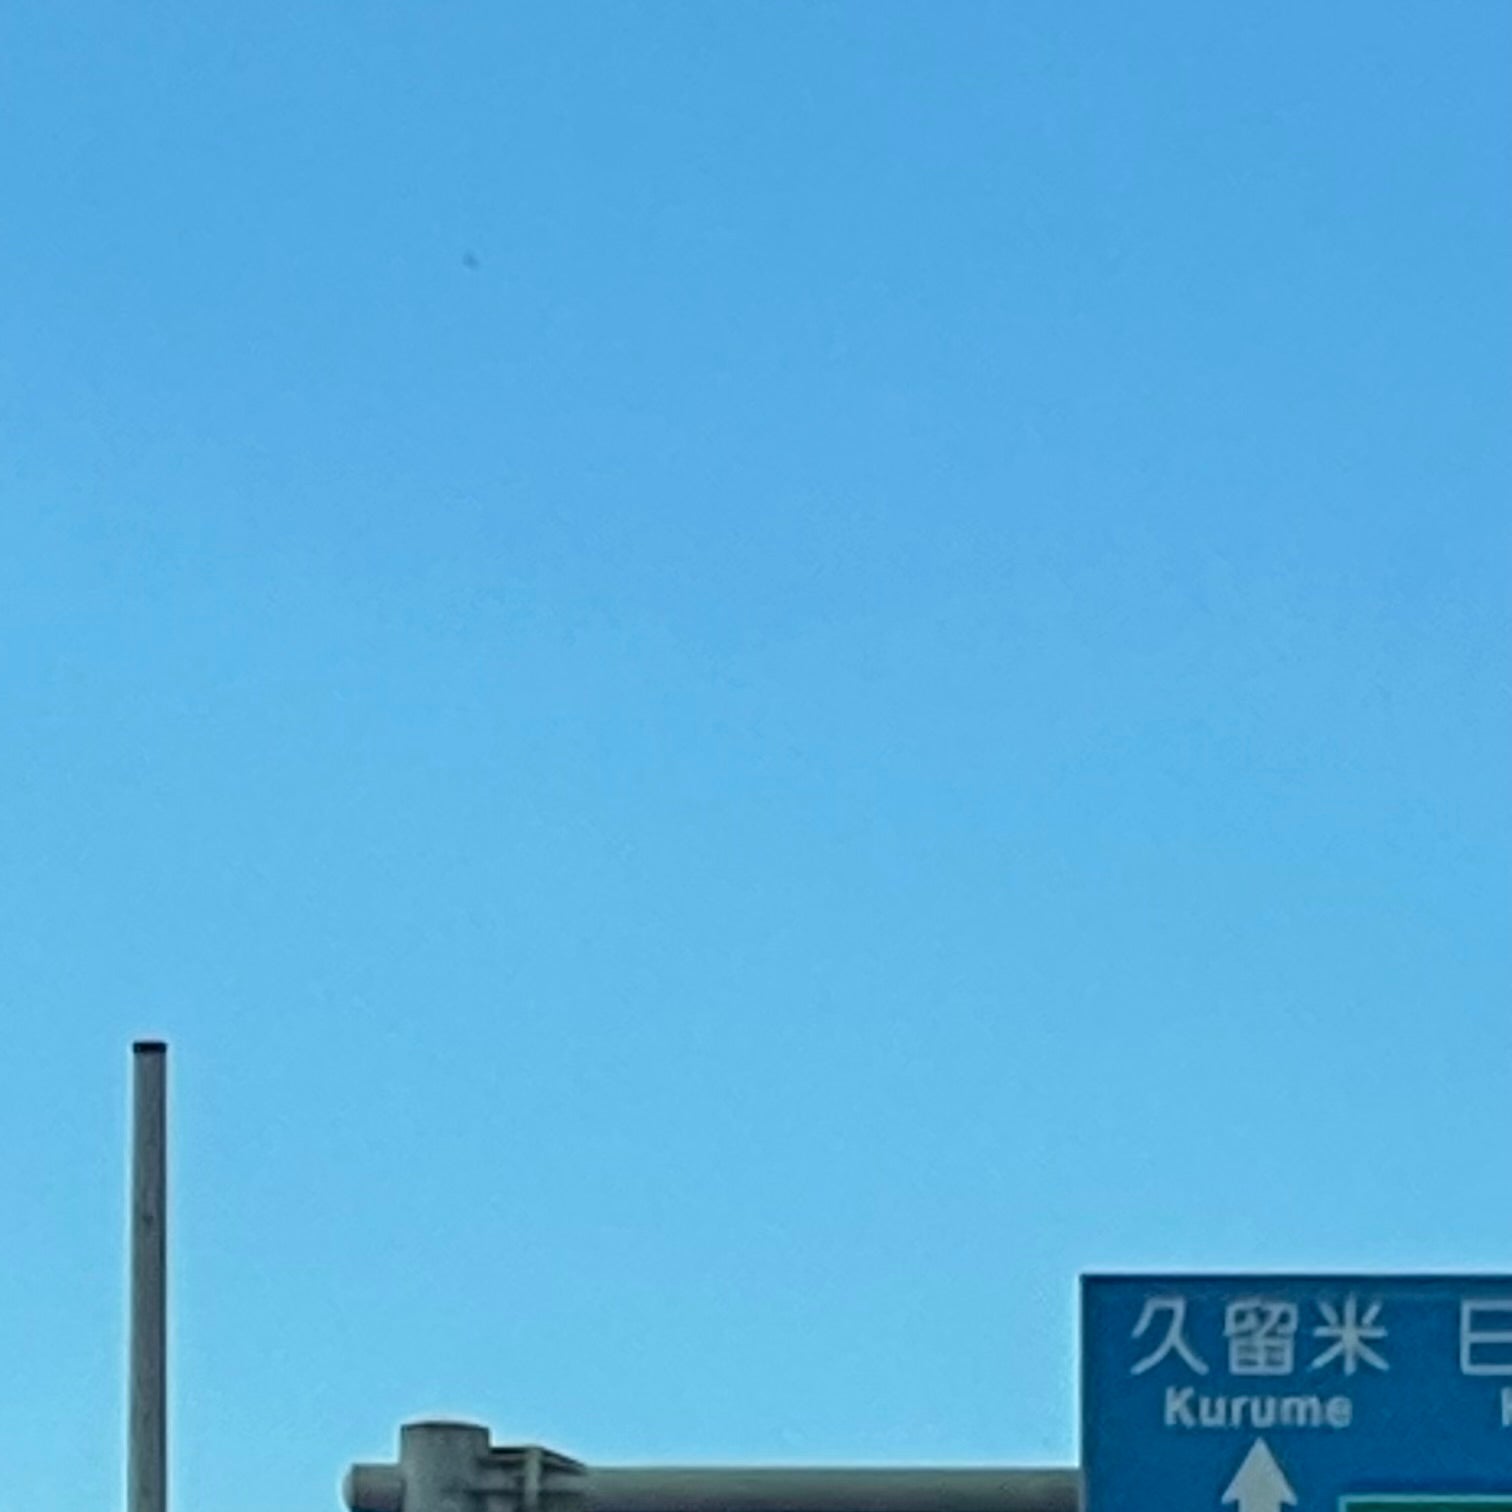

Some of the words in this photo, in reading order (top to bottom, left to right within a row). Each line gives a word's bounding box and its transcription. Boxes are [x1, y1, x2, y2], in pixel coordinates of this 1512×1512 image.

[1130, 1297, 1389, 1376] 久留米
[1164, 1387, 1353, 1428] Kurume
